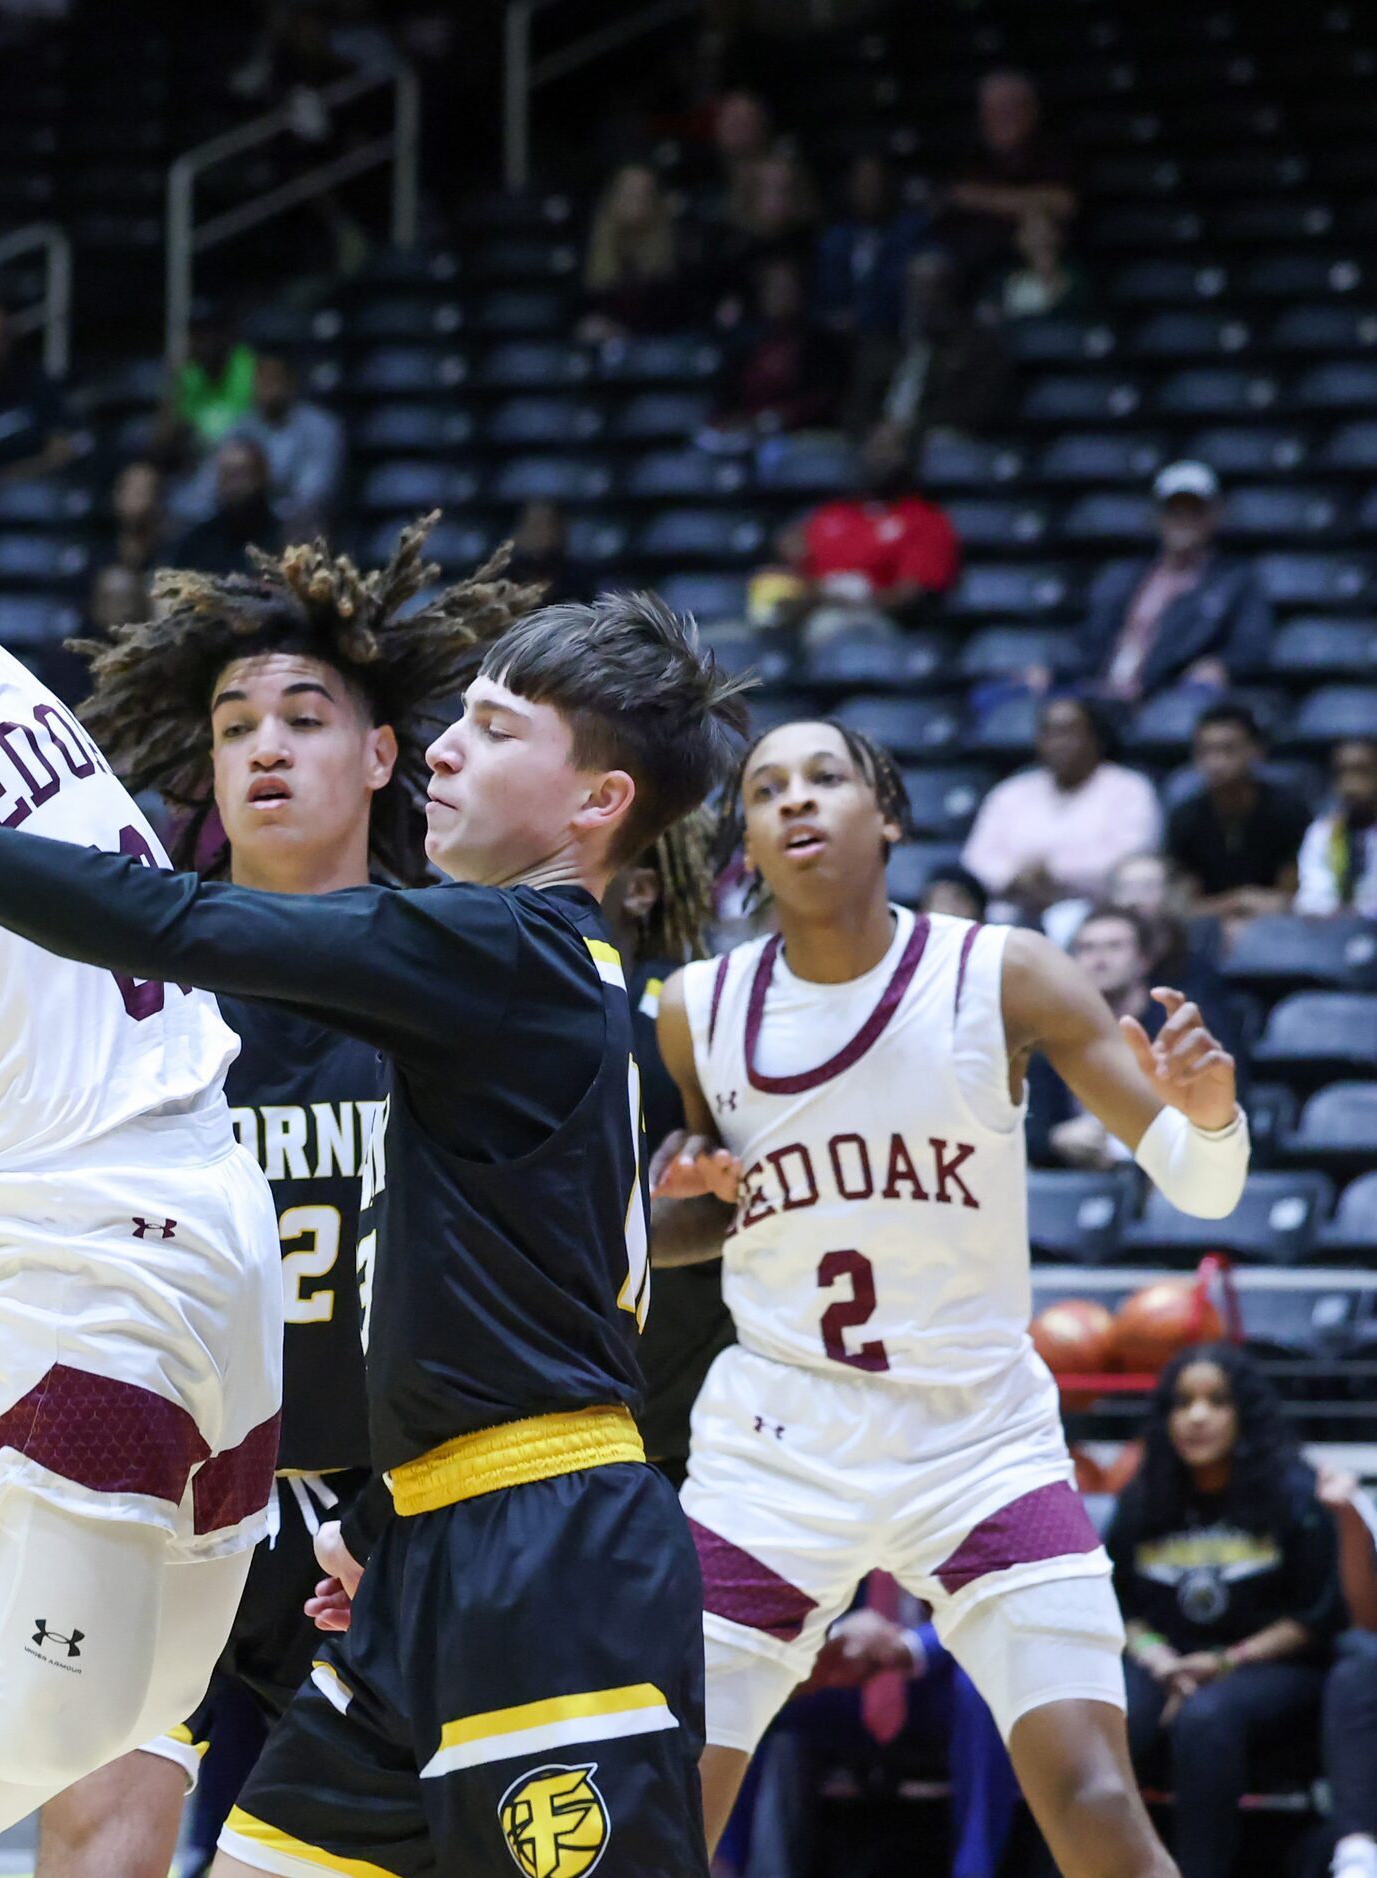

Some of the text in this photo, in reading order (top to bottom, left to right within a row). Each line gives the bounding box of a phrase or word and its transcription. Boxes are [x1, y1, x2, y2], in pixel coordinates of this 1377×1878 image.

[279, 1203, 341, 1325] 2
[817, 1249, 891, 1372] 2
[24, 1645, 83, 1675] UNDER ARMOUR
